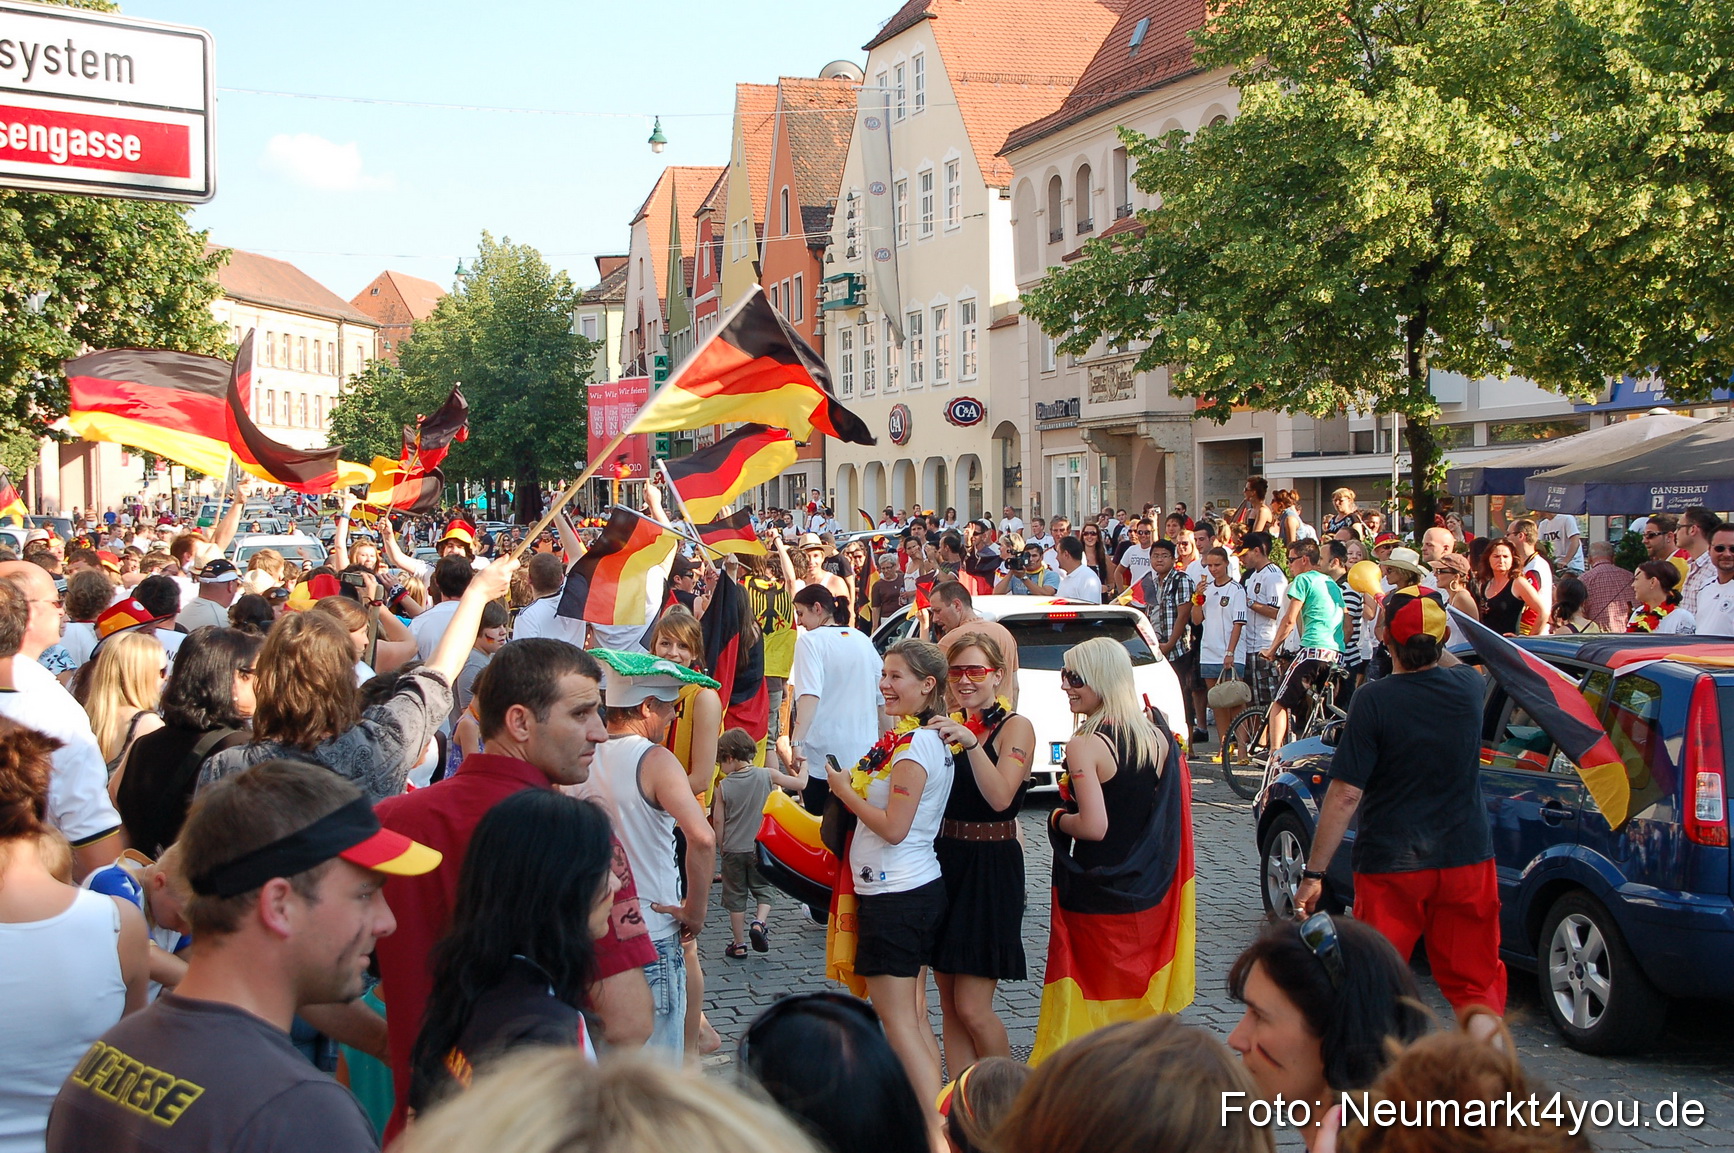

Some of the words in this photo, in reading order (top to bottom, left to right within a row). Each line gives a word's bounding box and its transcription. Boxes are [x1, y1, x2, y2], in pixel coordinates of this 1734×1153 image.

[0, 38, 134, 85] system
[605, 390, 617, 398] Wir
[955, 404, 978, 418] C&A
[890, 414, 902, 433] C&A
[1650, 485, 1709, 495] GANSBRÄU
